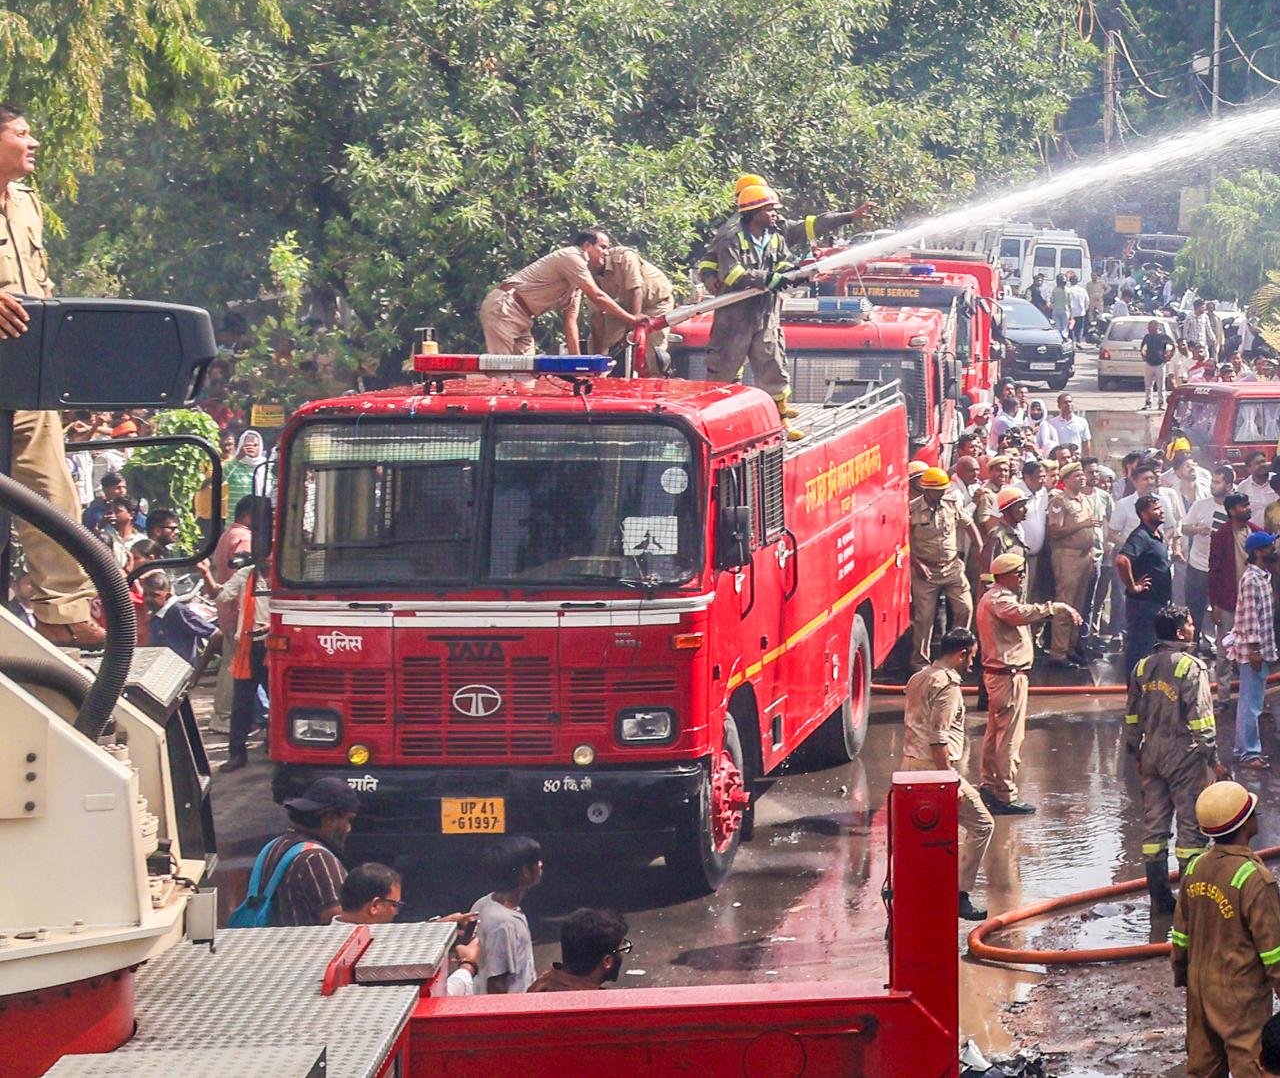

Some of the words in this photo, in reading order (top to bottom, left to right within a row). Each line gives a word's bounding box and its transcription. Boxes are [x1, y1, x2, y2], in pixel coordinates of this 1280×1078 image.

[868, 287, 886, 297] FIRE
[317, 630, 363, 655] पुलिस
[447, 641, 504, 662] TATA
[460, 801, 477, 815] UP
[480, 801, 495, 815] 41
